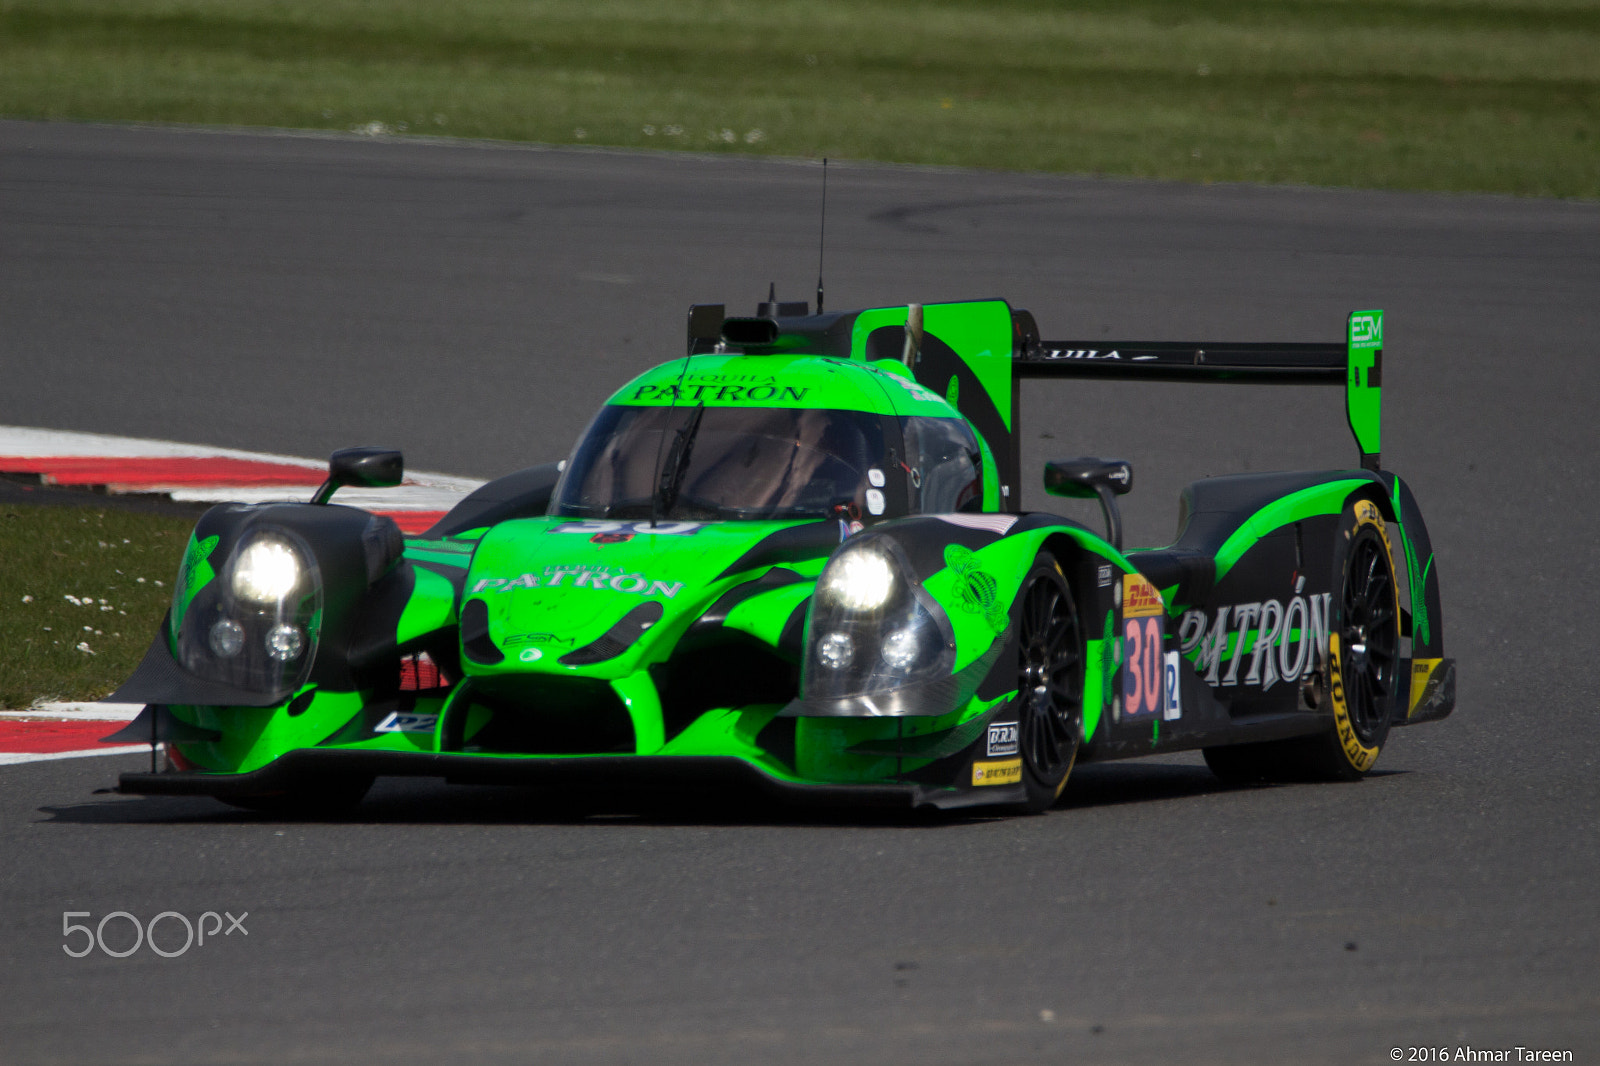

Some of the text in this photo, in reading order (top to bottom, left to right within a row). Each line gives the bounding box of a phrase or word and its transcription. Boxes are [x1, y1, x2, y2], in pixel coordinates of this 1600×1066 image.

[1352, 316, 1382, 341] ESM
[632, 383, 809, 402] PATRÓN
[472, 570, 685, 598] PATRÓN
[1179, 576, 1332, 692] PATRÓN
[1125, 617, 1160, 714] 30
